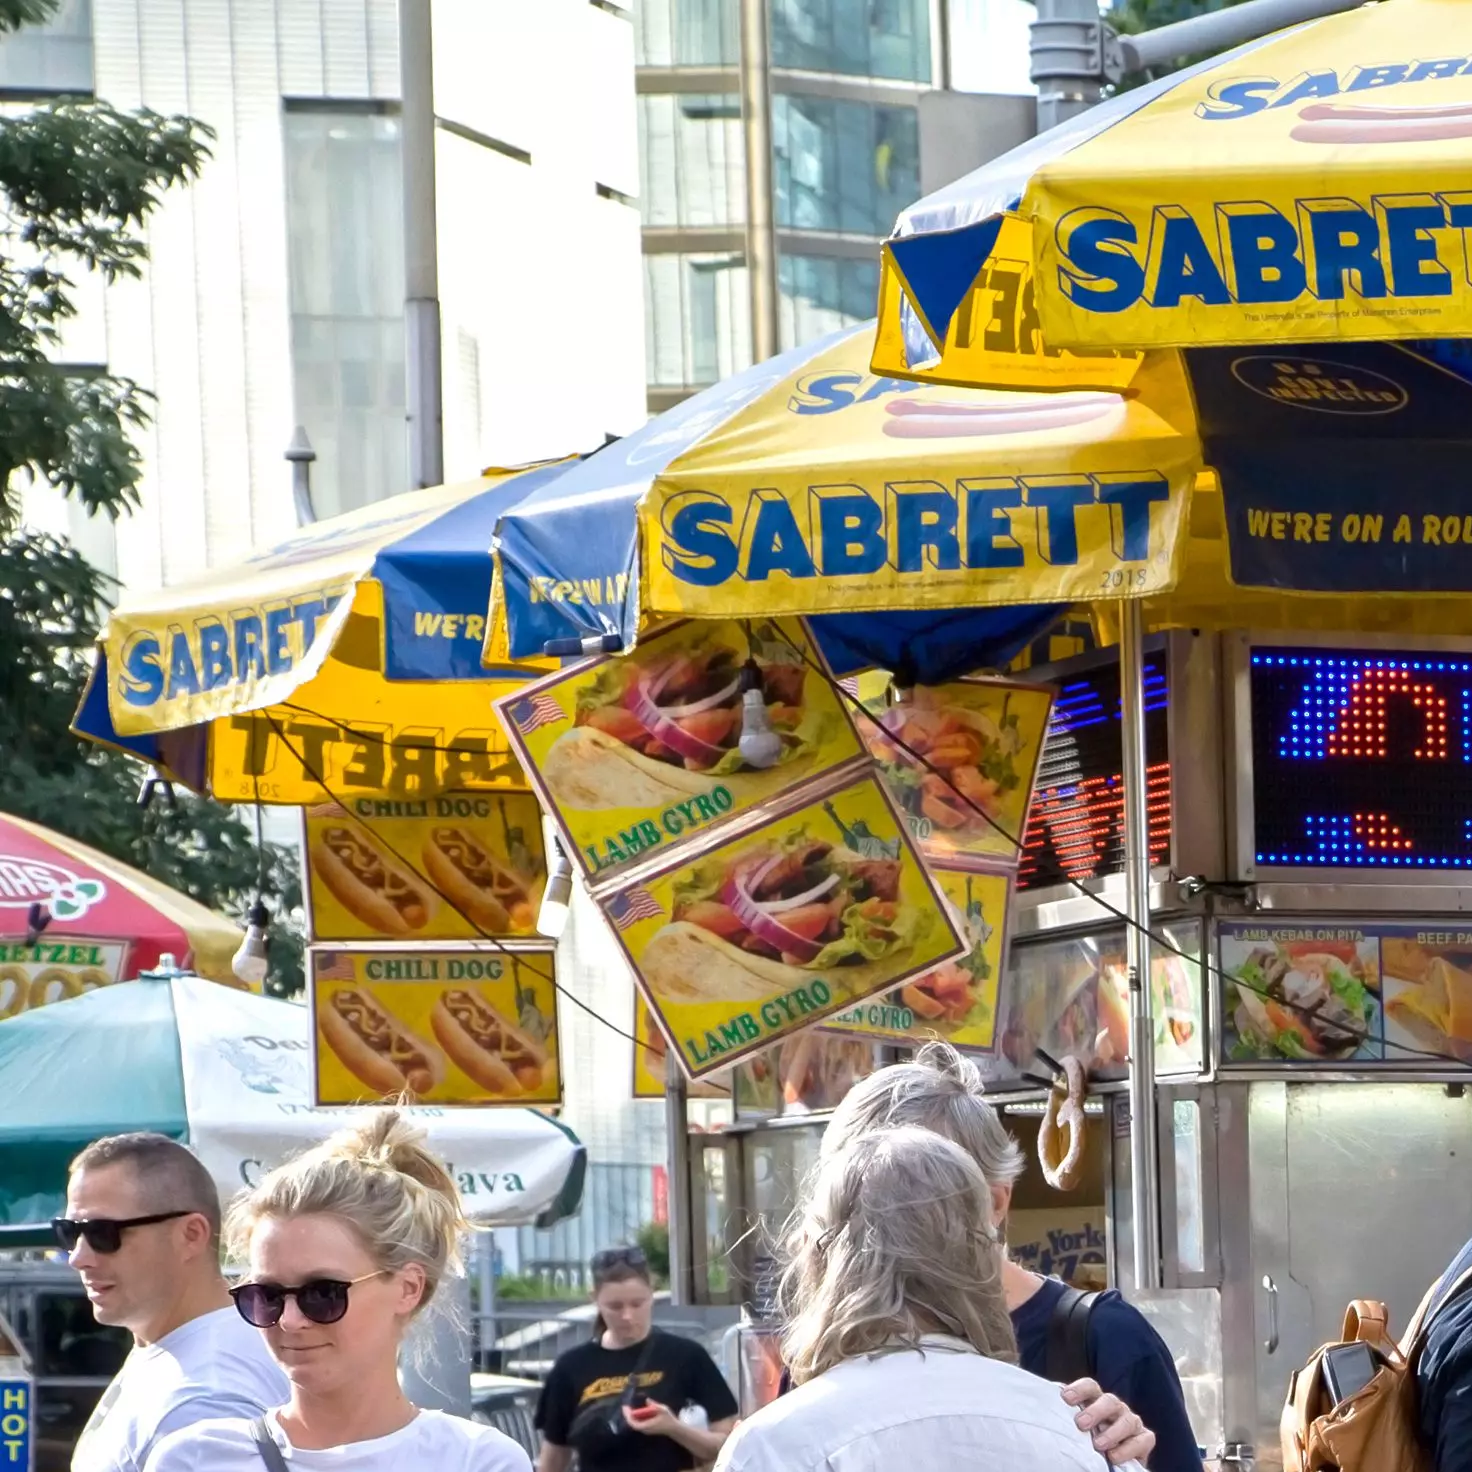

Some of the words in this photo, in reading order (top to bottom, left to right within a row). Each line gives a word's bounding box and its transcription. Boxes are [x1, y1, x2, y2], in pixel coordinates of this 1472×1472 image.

[661, 470, 1169, 586] SABRETT
[1248, 509, 1332, 543] WE'RE
[1342, 514, 1384, 543] ON
[1392, 515, 1413, 543] A
[1100, 568, 1148, 590] 2018
[356, 797, 431, 818] CHILI
[436, 799, 490, 818] DOG
[585, 819, 657, 877] LAMB
[655, 783, 734, 840] GYRO
[1234, 929, 1269, 941] LAMB
[1272, 929, 1313, 942] KEBAB
[1317, 930, 1335, 941] ON
[1338, 930, 1365, 943] PITA
[1417, 932, 1454, 944] BEEF
[365, 958, 444, 981] CHILI
[448, 958, 504, 981] DOG
[684, 1012, 760, 1064] LAMB
[759, 979, 832, 1034] GYRO
[868, 1005, 914, 1030] GYRO
[1047, 1222, 1105, 1255] York
[0, 1387, 26, 1464] HOT
